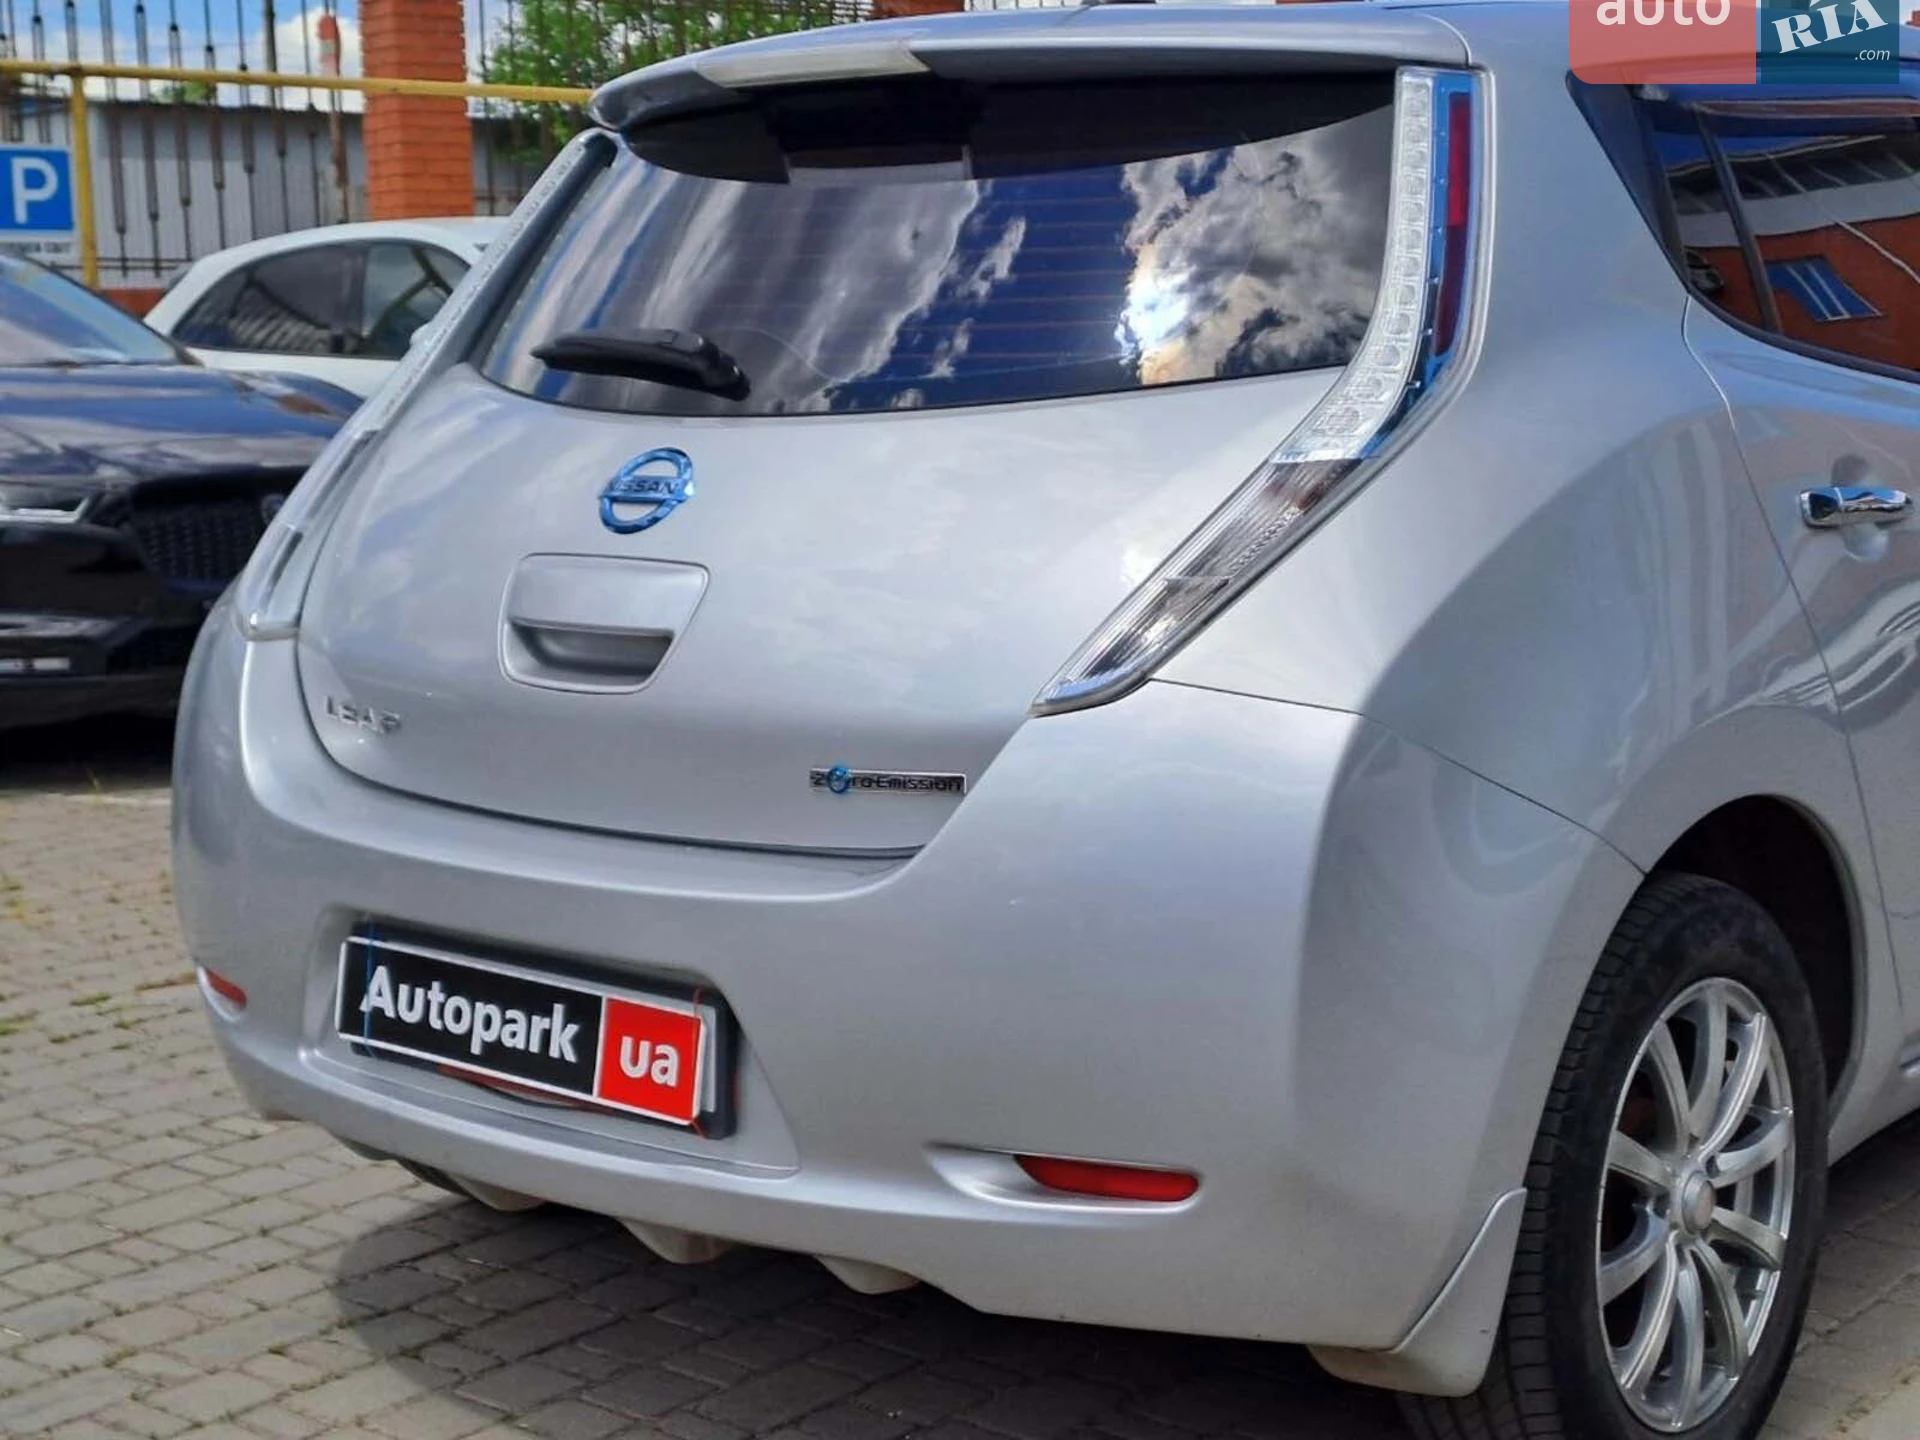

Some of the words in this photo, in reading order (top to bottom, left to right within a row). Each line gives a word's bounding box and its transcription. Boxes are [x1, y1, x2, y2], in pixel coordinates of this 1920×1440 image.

[11, 156, 59, 224] P
[358, 965, 580, 1063] Autopark
[619, 1034, 680, 1088] ua
